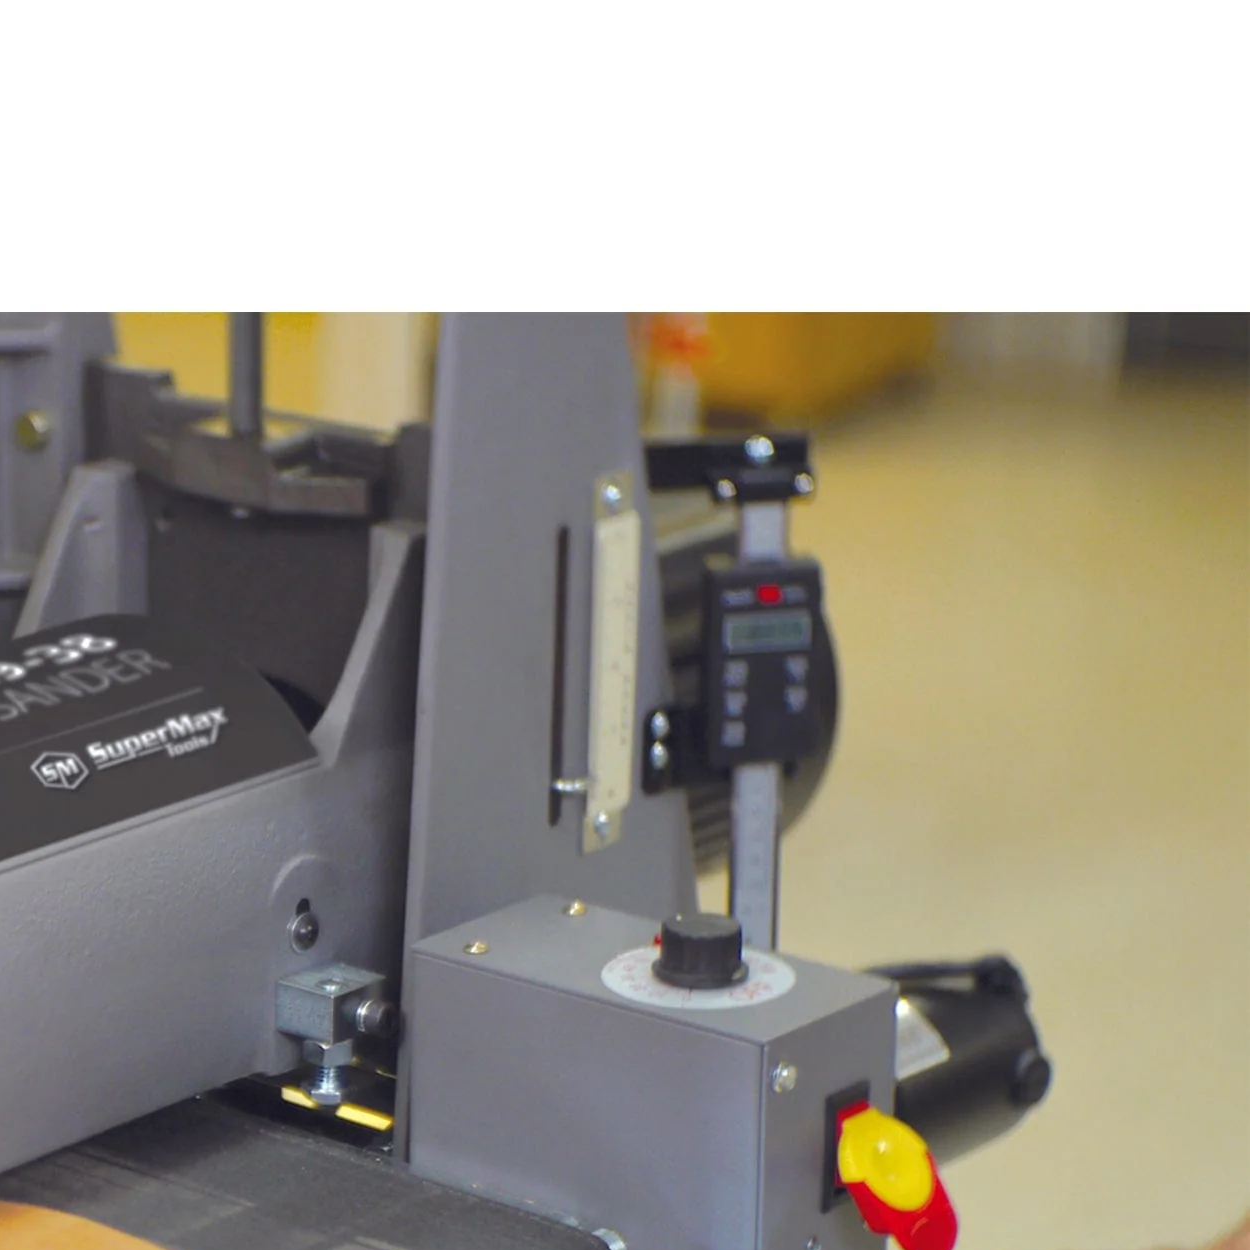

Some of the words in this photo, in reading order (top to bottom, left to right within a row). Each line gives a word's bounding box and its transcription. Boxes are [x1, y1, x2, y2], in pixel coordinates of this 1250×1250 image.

[86, 706, 229, 765] SuperMax
[163, 735, 211, 758] Tools
[40, 758, 79, 788] SM
